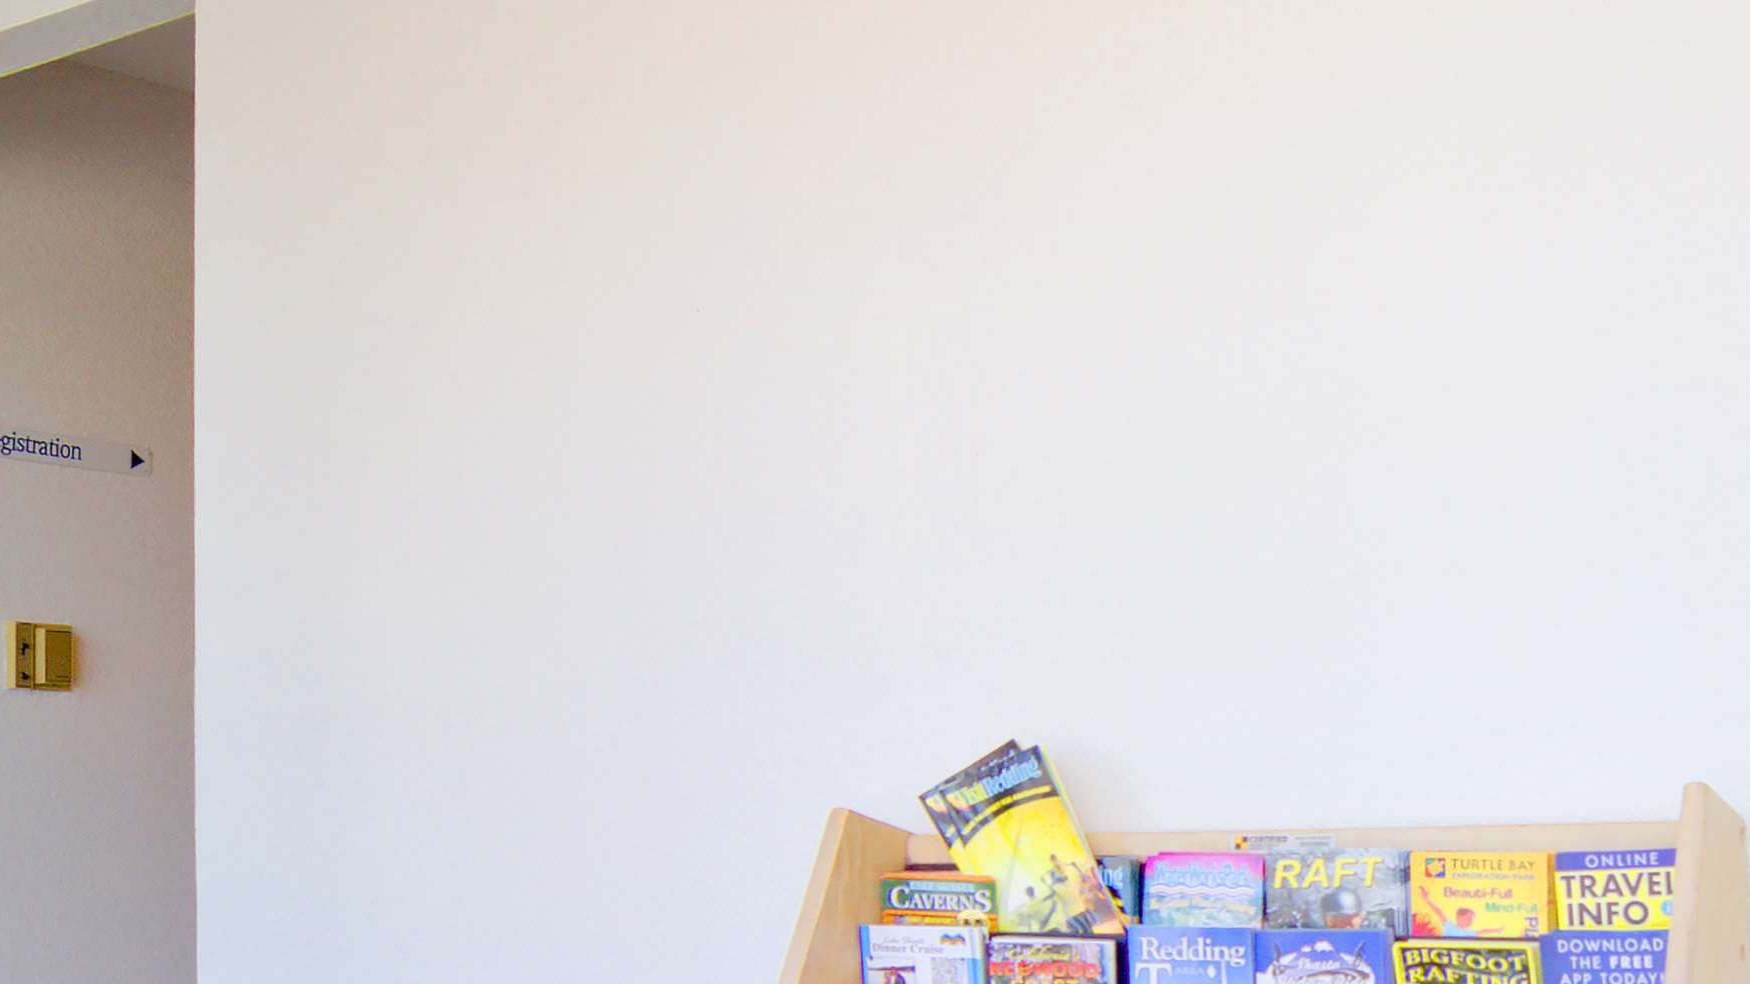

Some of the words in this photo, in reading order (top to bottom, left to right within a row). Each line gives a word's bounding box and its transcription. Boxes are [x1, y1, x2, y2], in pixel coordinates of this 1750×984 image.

[1273, 855, 1384, 889] RAFT
[1451, 858, 1505, 871] TURTLE
[1509, 858, 1536, 871] BAY
[1585, 852, 1659, 868] ONLINE
[889, 881, 991, 914] CAVERNS
[1568, 901, 1649, 927] INFO
[1140, 937, 1246, 967] Redding
[1557, 938, 1664, 953] DOWNLOAD
[1404, 946, 1527, 972] BIGFOOT
[1570, 956, 1602, 969] THE
[1610, 955, 1652, 969] FREE
